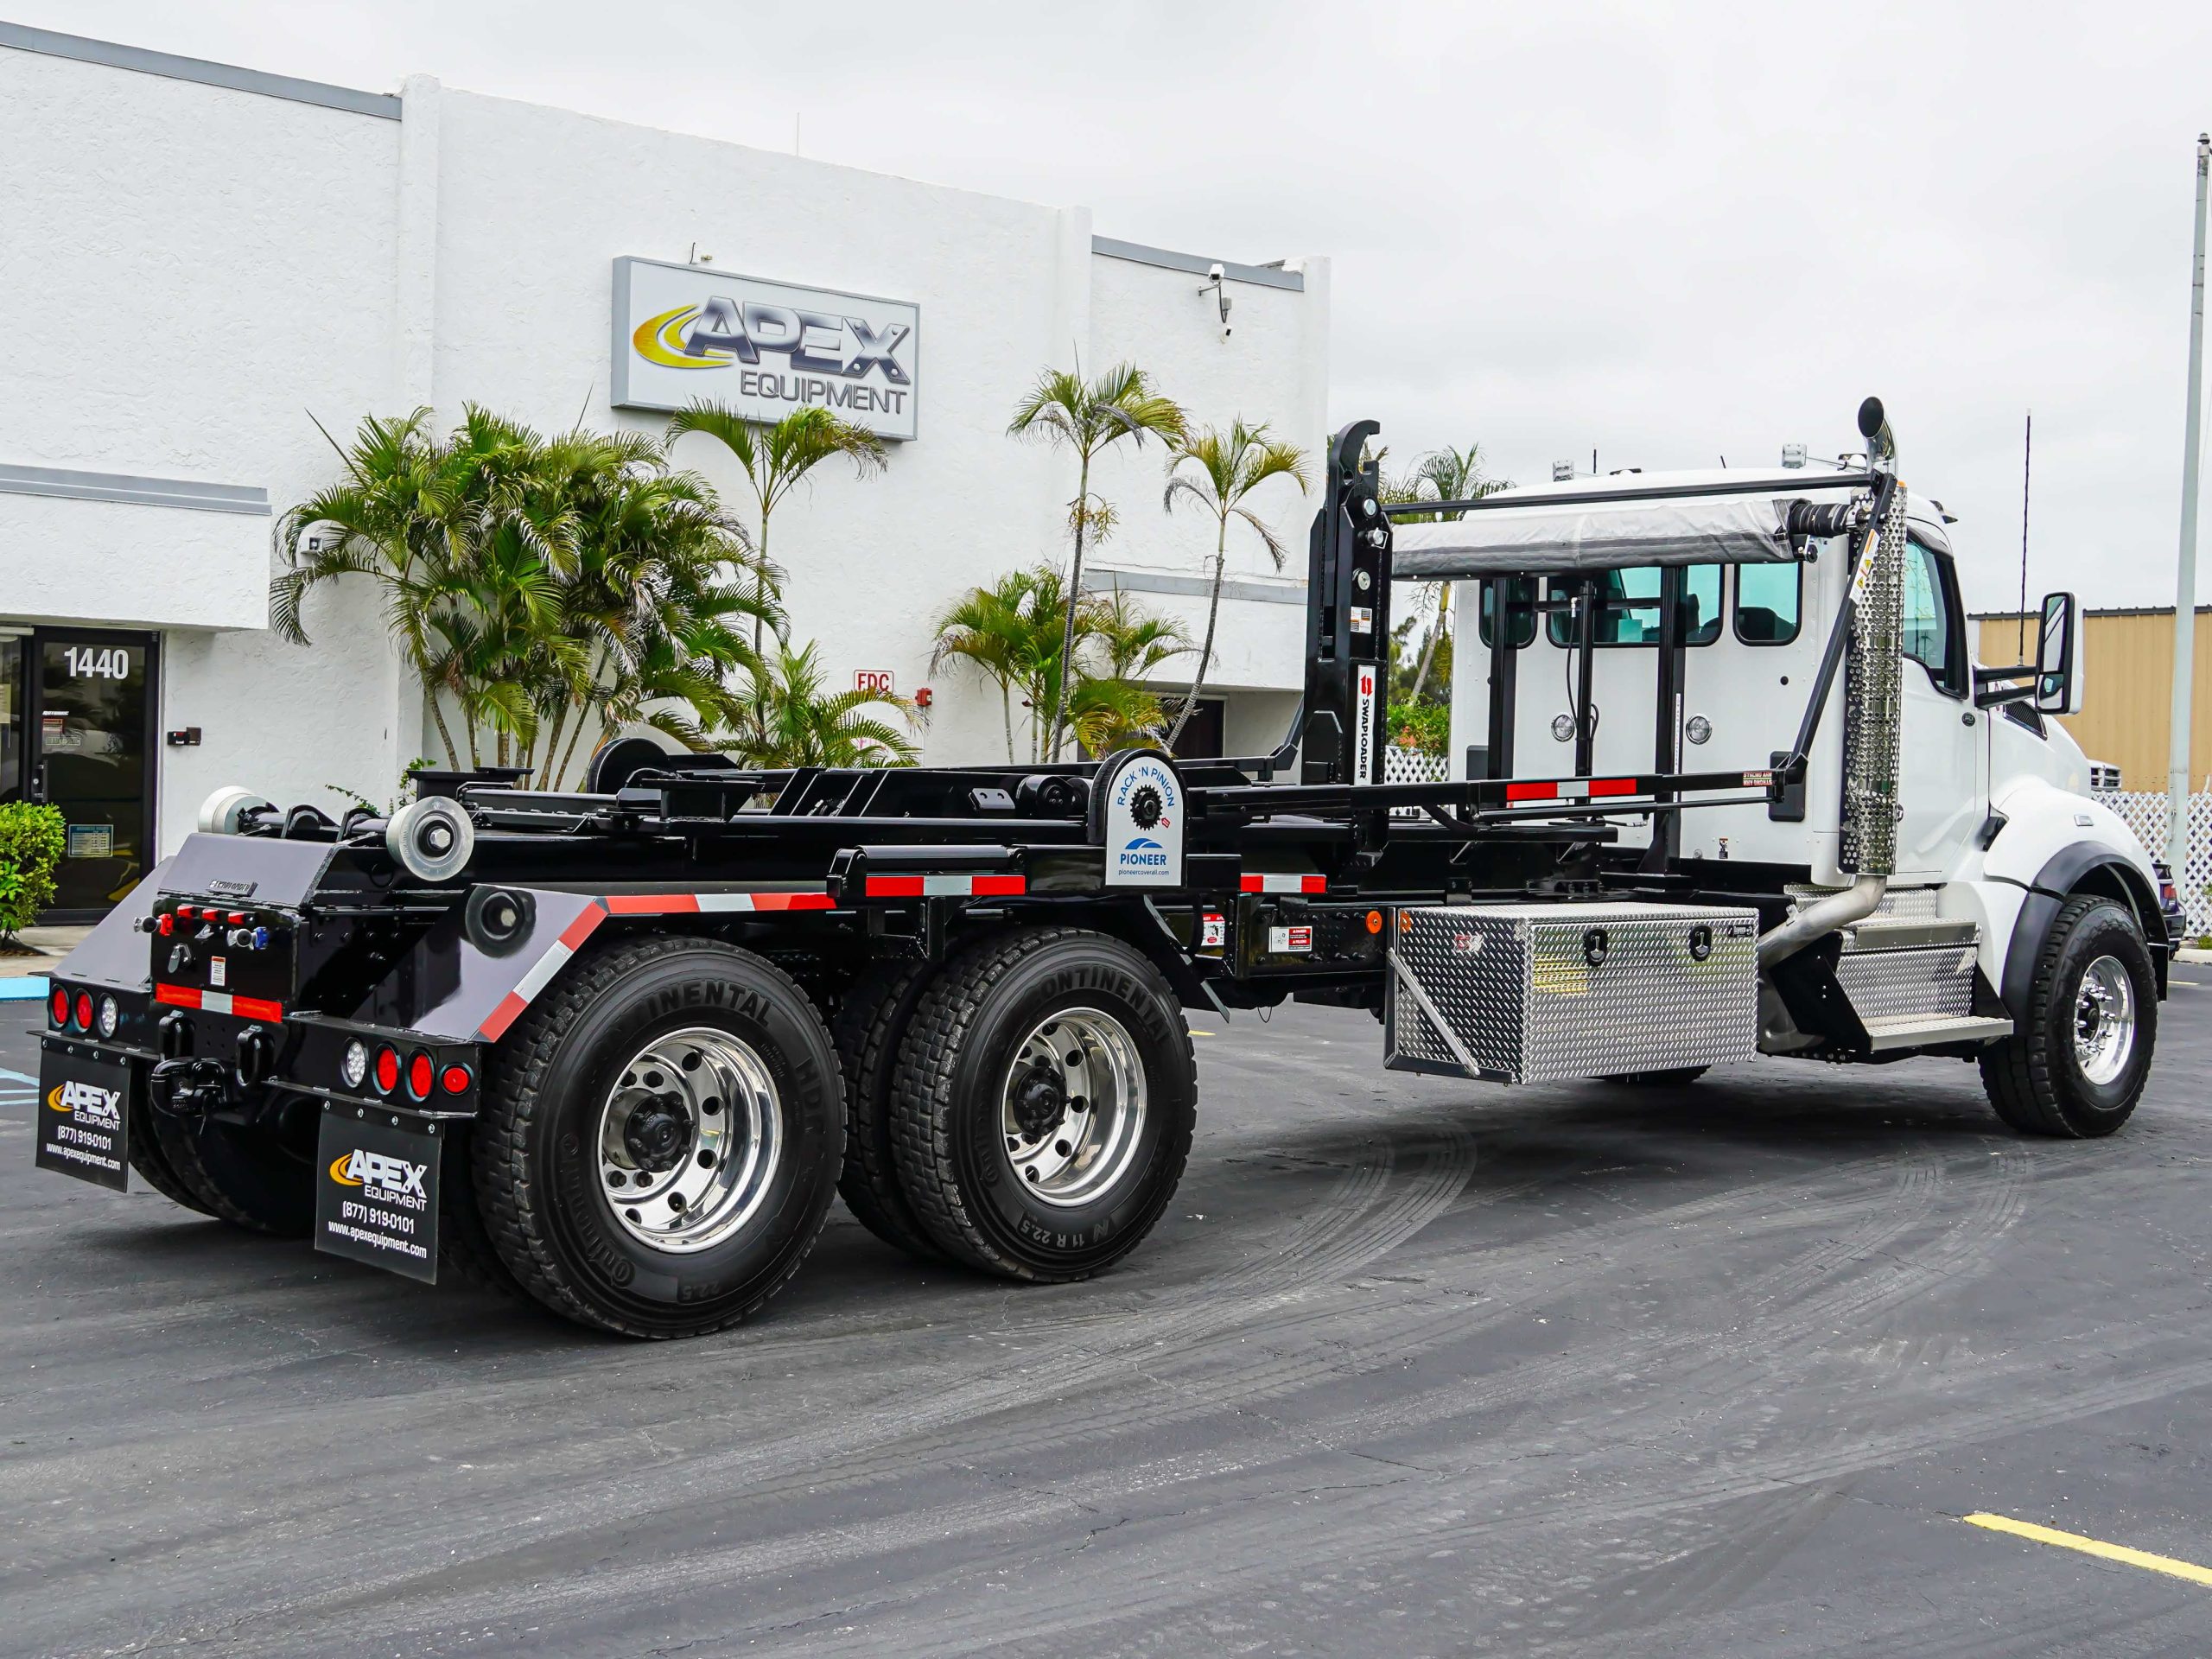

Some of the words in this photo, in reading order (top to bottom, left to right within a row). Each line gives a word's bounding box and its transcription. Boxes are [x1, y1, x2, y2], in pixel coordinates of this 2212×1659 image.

[683, 296, 911, 384] APEX
[741, 369, 907, 414] EQUIPMENT
[64, 647, 129, 679] 1440
[857, 672, 889, 692] FDC
[1359, 698, 1370, 779] SWAPLOADER
[1117, 771, 1137, 805] RACK
[1150, 767, 1175, 807] PINION
[1120, 853, 1166, 866] PIONEER
[647, 980, 774, 1027] INENTAL
[60, 1080, 121, 1121] APEX
[74, 1109, 121, 1131] EQUIPMENT
[58, 1125, 77, 1143] (877)
[78, 1132, 111, 1150] 919-0101
[46, 1142, 121, 1171] www.apexequipment.com
[346, 1148, 428, 1198] APEX
[364, 1185, 428, 1211] EQUIPMENT
[342, 1200, 367, 1224] (877)
[369, 1207, 415, 1234] 919-0101
[1020, 1219, 1052, 1244] 22.5
[327, 1220, 428, 1258] www.apexequipment.com
[1056, 1233, 1068, 1248] R
[1072, 1233, 1085, 1247] 11
